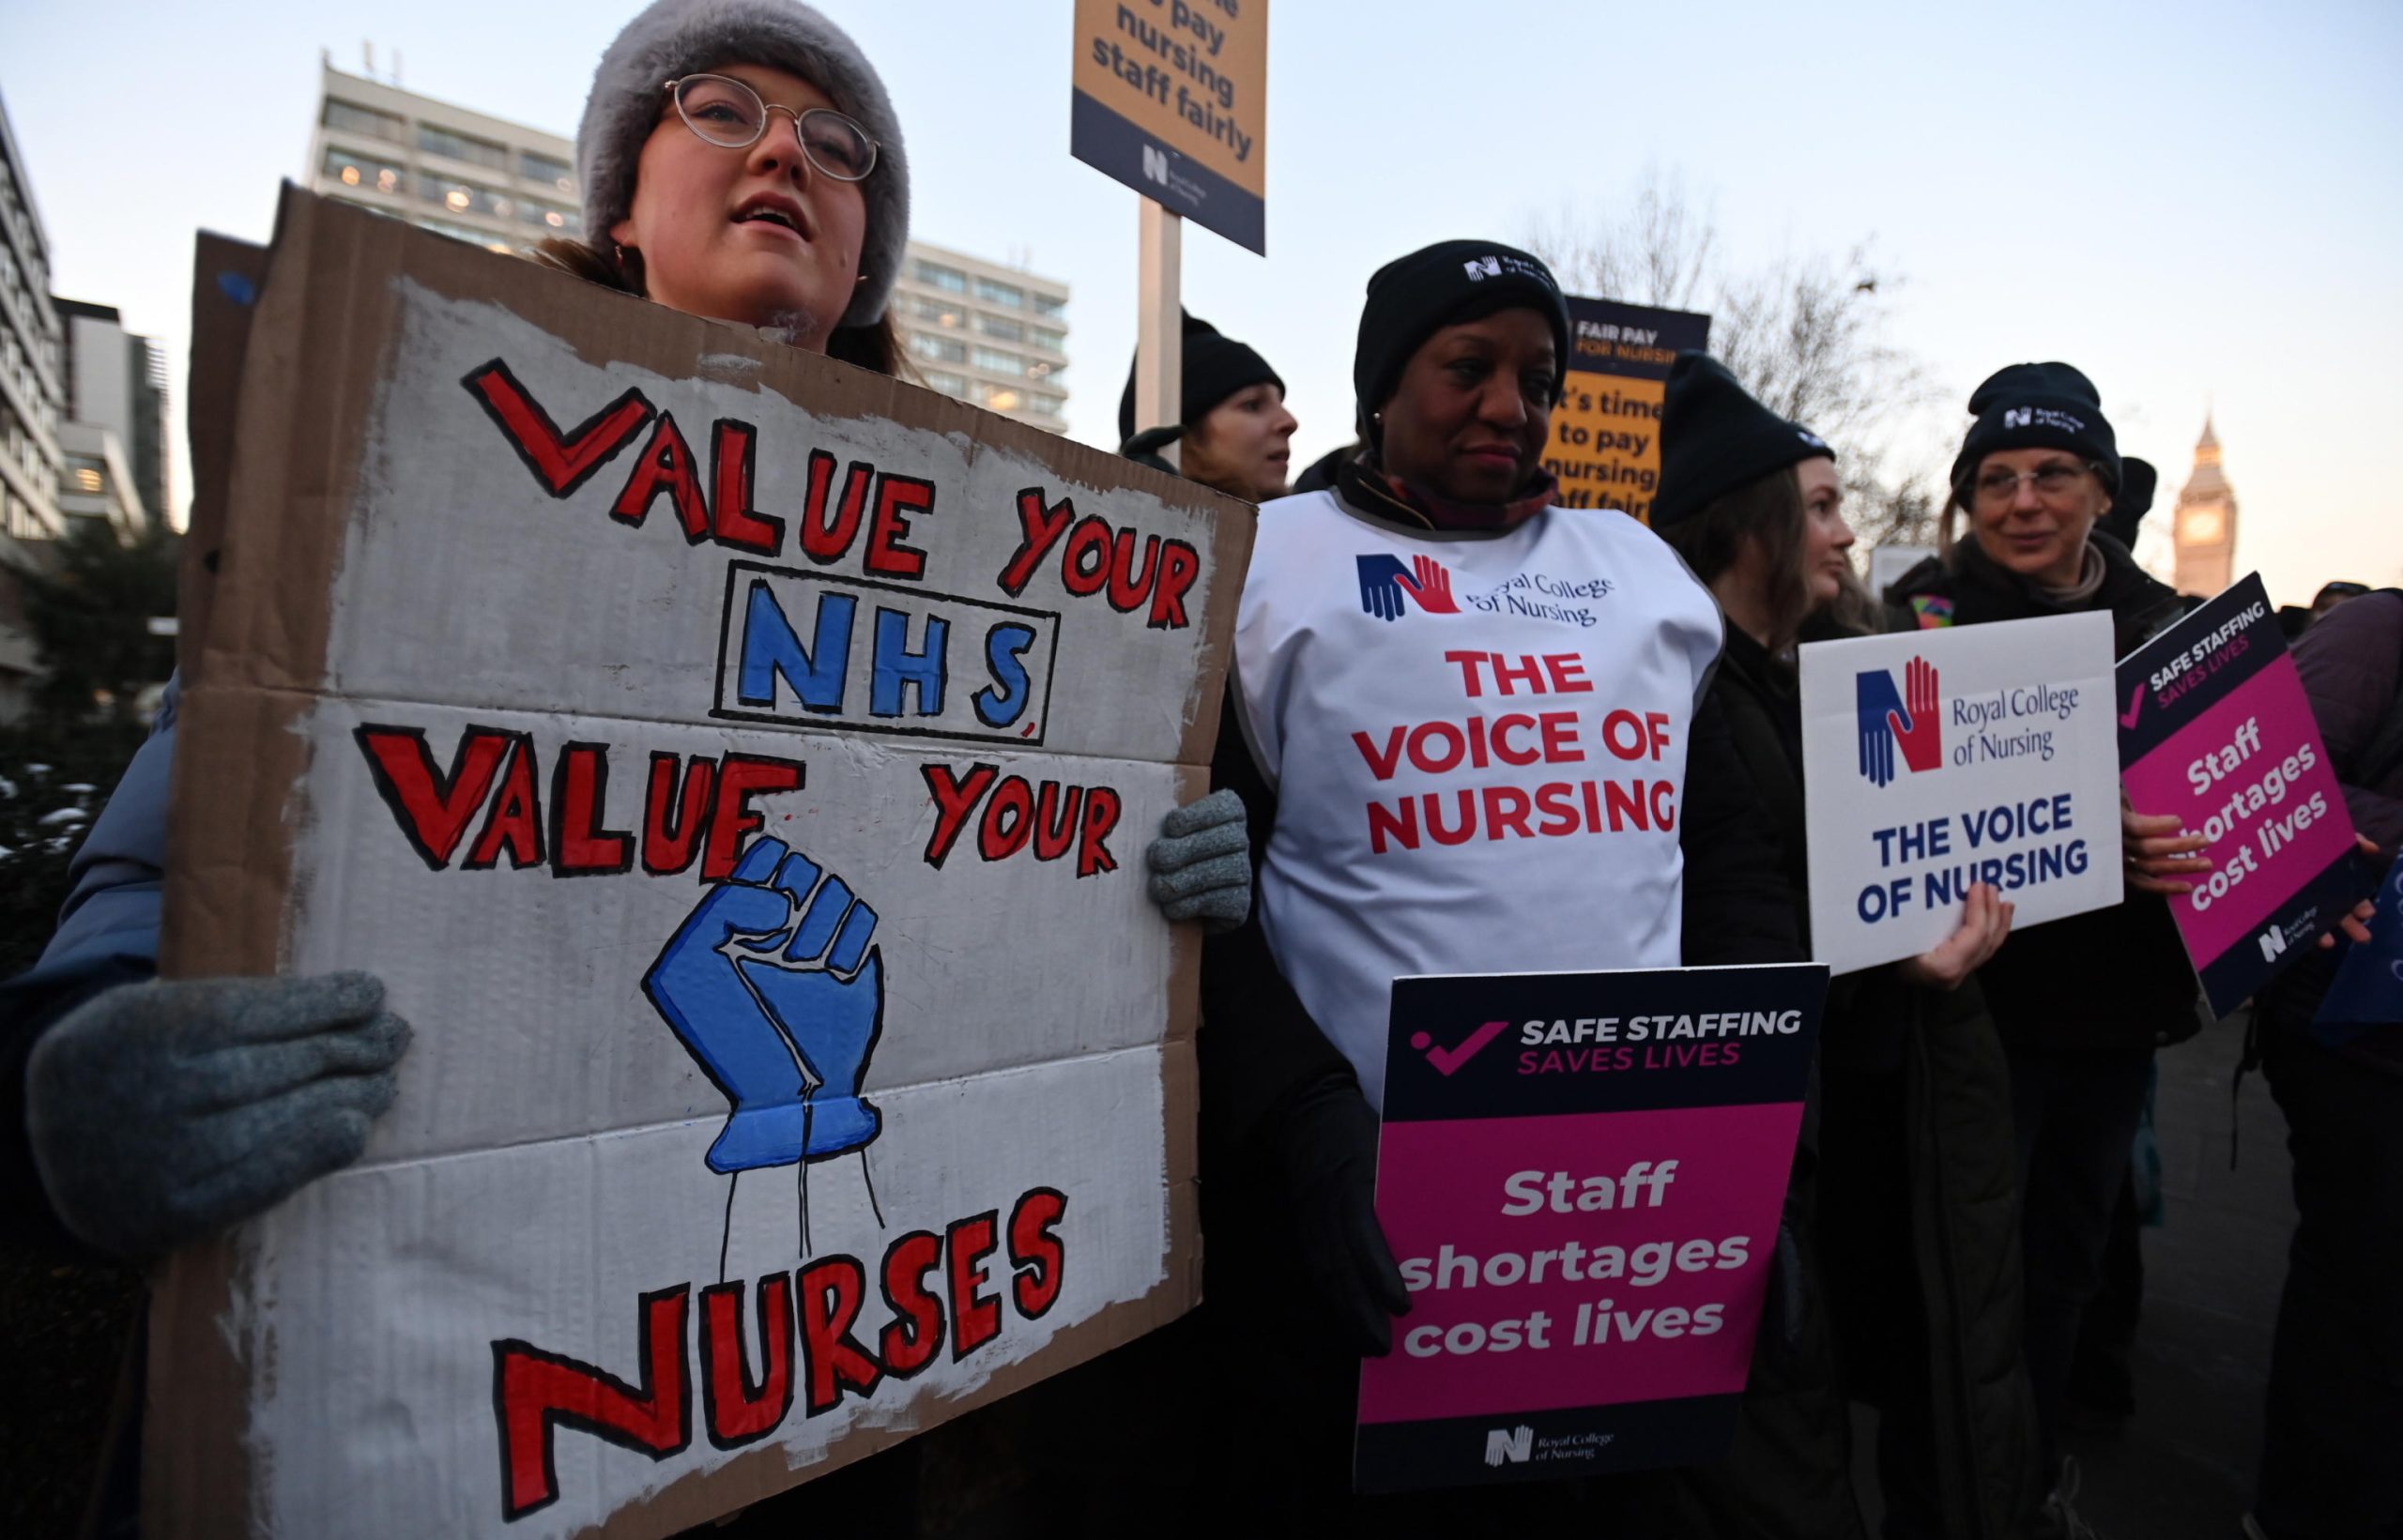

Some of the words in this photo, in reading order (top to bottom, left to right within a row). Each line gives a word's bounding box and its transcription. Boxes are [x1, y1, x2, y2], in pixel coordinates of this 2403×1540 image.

[1117, 4, 1234, 109] nursing
[1093, 37, 1170, 105] staff
[1177, 86, 1252, 162] fairly
[1577, 340, 1612, 356] FOR
[1616, 344, 1676, 363] NURSI
[1578, 321, 1619, 341] FAIR
[1621, 327, 1658, 345] PAY
[1558, 387, 1592, 411] t's
[1600, 389, 1663, 419] time
[1560, 421, 1588, 445] to
[1596, 429, 1649, 457] pay
[460, 356, 936, 581] VALUE
[997, 486, 1201, 630] YOUR
[1545, 457, 1655, 492] nursing
[1477, 595, 1501, 612] of
[1508, 595, 1597, 627] Nursing
[1535, 574, 1615, 600] College
[1445, 650, 1594, 697] THE
[2150, 651, 2193, 691] SAFE
[2192, 602, 2265, 662] STAFFING
[2158, 665, 2207, 709] SAVES
[2208, 634, 2249, 673] LIVES
[1952, 691, 2006, 733] Royal
[2012, 684, 2079, 719] College
[1351, 711, 1585, 781] VOICE
[1602, 709, 1670, 761] OF
[1953, 735, 1975, 766] of
[1981, 728, 2055, 762] Nursing
[2187, 716, 2262, 796] Staff
[353, 723, 805, 885] VALUE
[923, 762, 1122, 878] YOUR
[1367, 780, 1675, 854] NURSING
[1873, 817, 1951, 867] THE
[1962, 794, 2073, 847] VOICE
[2192, 845, 2258, 911] cost
[2258, 791, 2327, 859] lives
[1858, 877, 1912, 923] OF
[1925, 839, 2089, 910] NURSING
[1520, 1019, 1618, 1046] SAFE
[1626, 1009, 1802, 1042] STAFFING
[1517, 1046, 1633, 1075] SAVES
[1644, 1042, 1741, 1070] LIVES
[1501, 1159, 1679, 1216] Staff
[1398, 1235, 1751, 1291] shortages
[491, 1186, 1068, 1523] NURSES
[1403, 1311, 1553, 1358] cost
[1573, 1298, 1725, 1347] lives
[1538, 1436, 1570, 1450] Royal
[1572, 1433, 1615, 1446] College
[1552, 1448, 1596, 1460] Nursing
